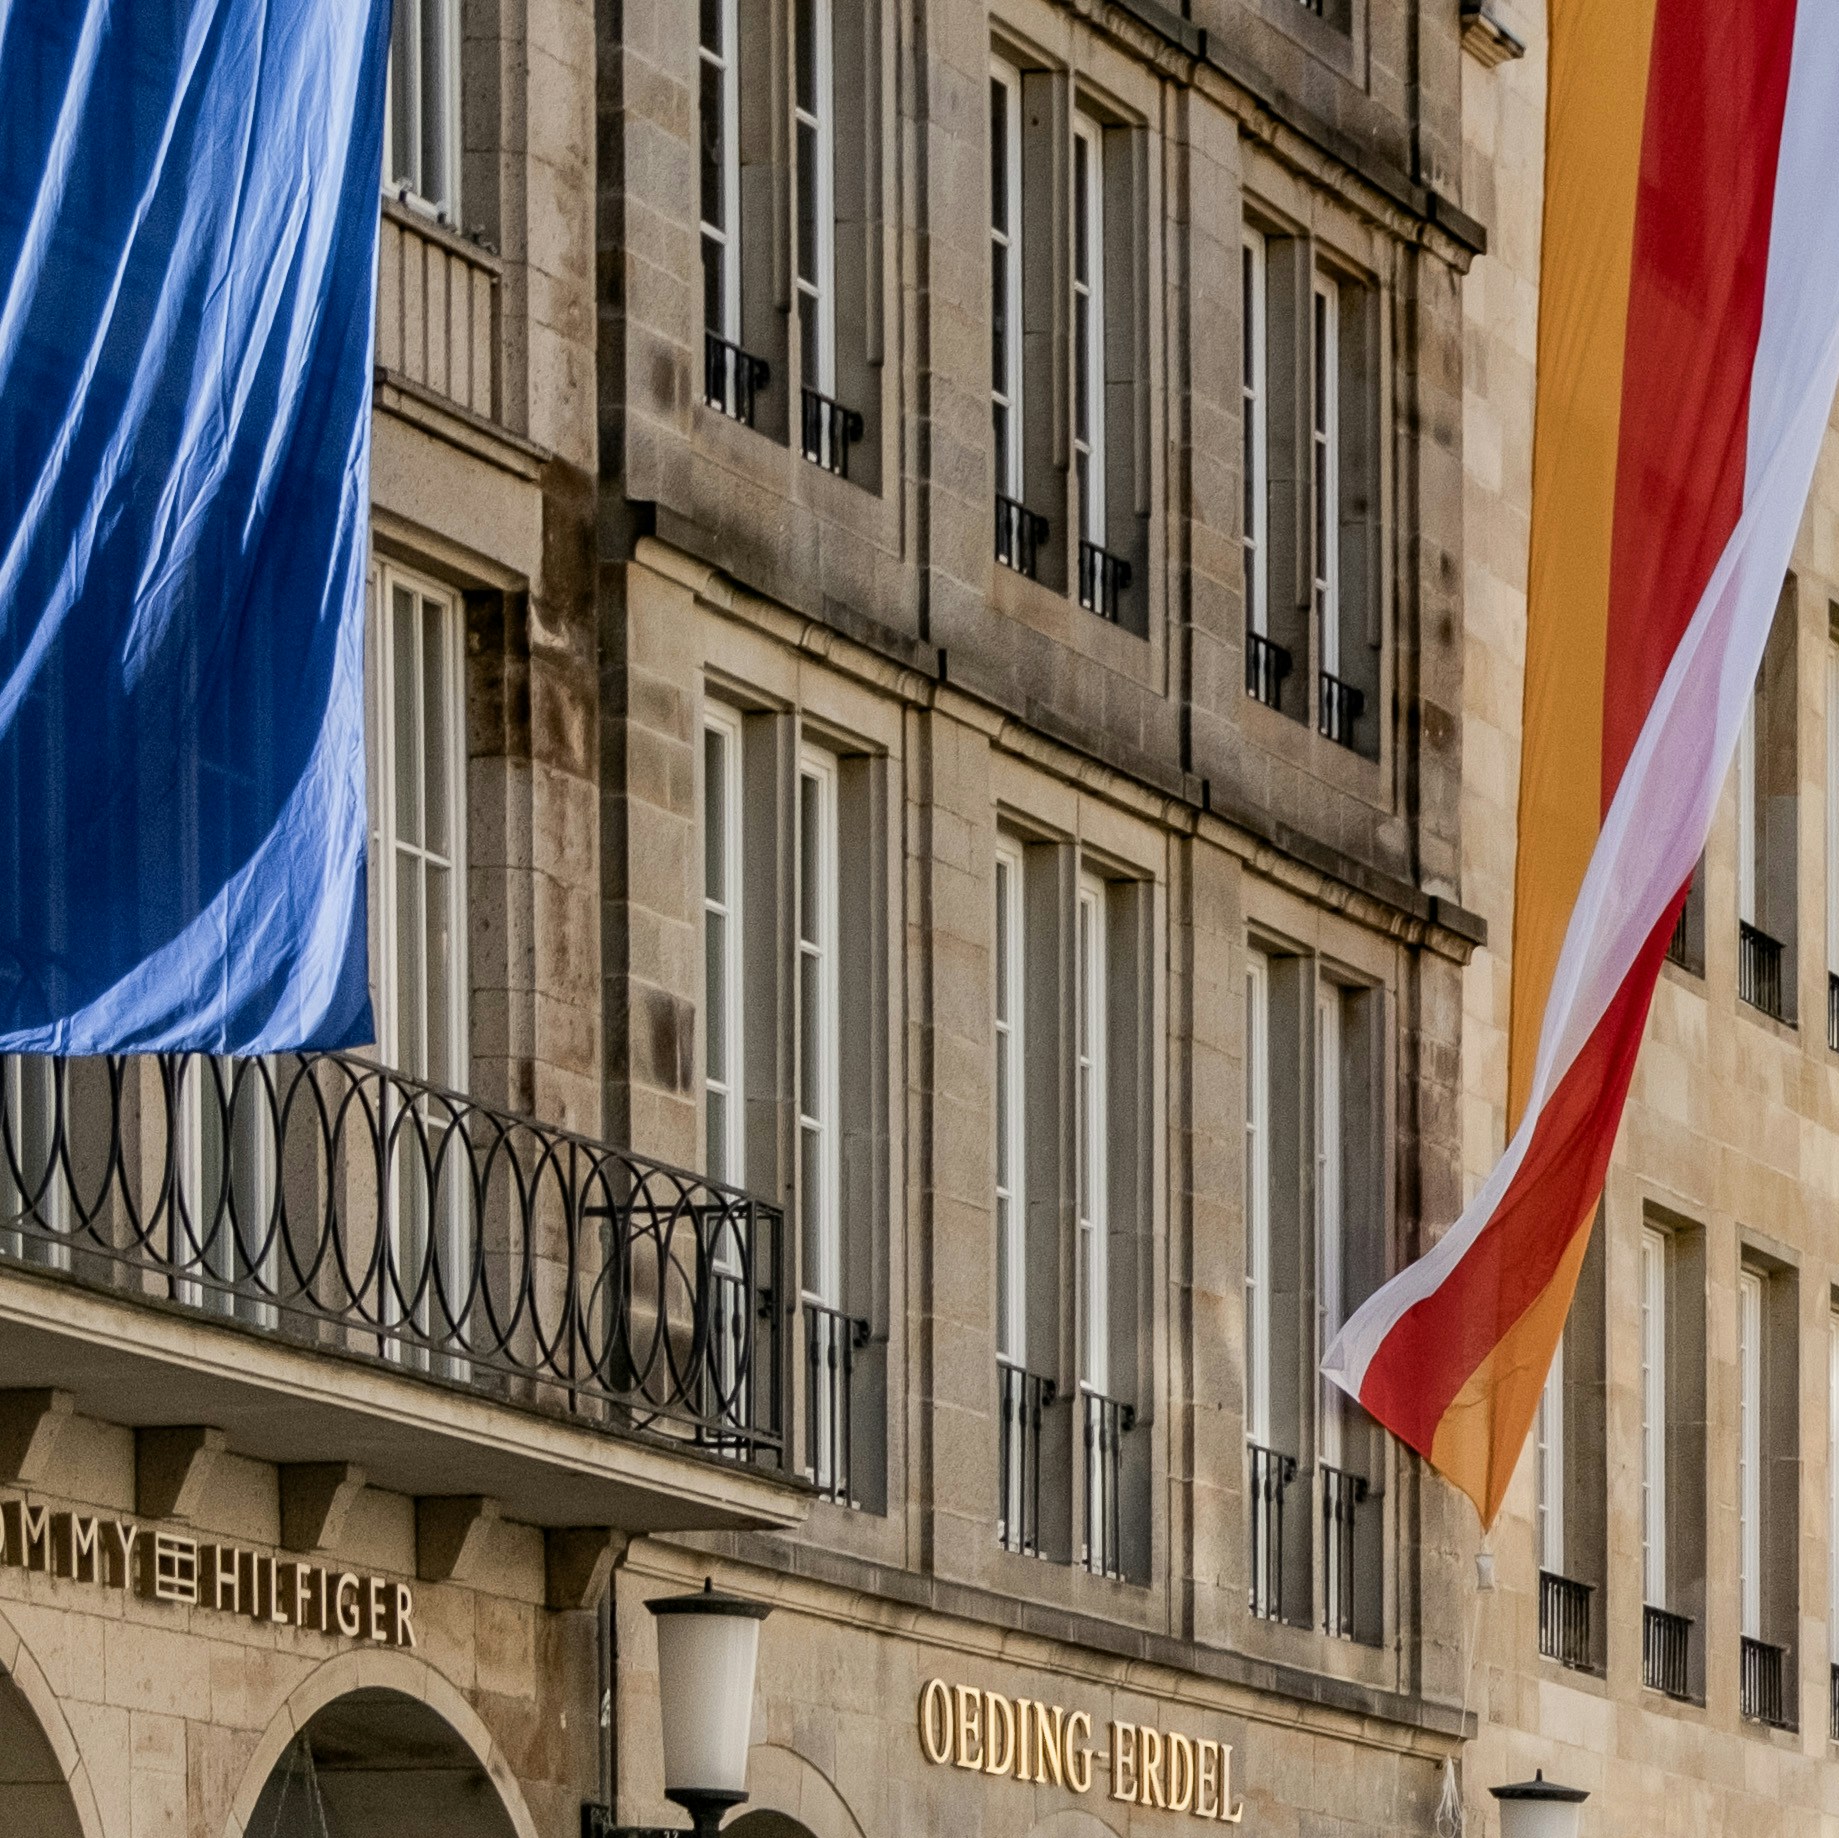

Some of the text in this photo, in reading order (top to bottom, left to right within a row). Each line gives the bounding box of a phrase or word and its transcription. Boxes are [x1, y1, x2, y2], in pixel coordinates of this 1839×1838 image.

[0, 1500, 417, 1648] MMY HILFIGER
[921, 1677, 1244, 1823] OEDING-ERDEL
